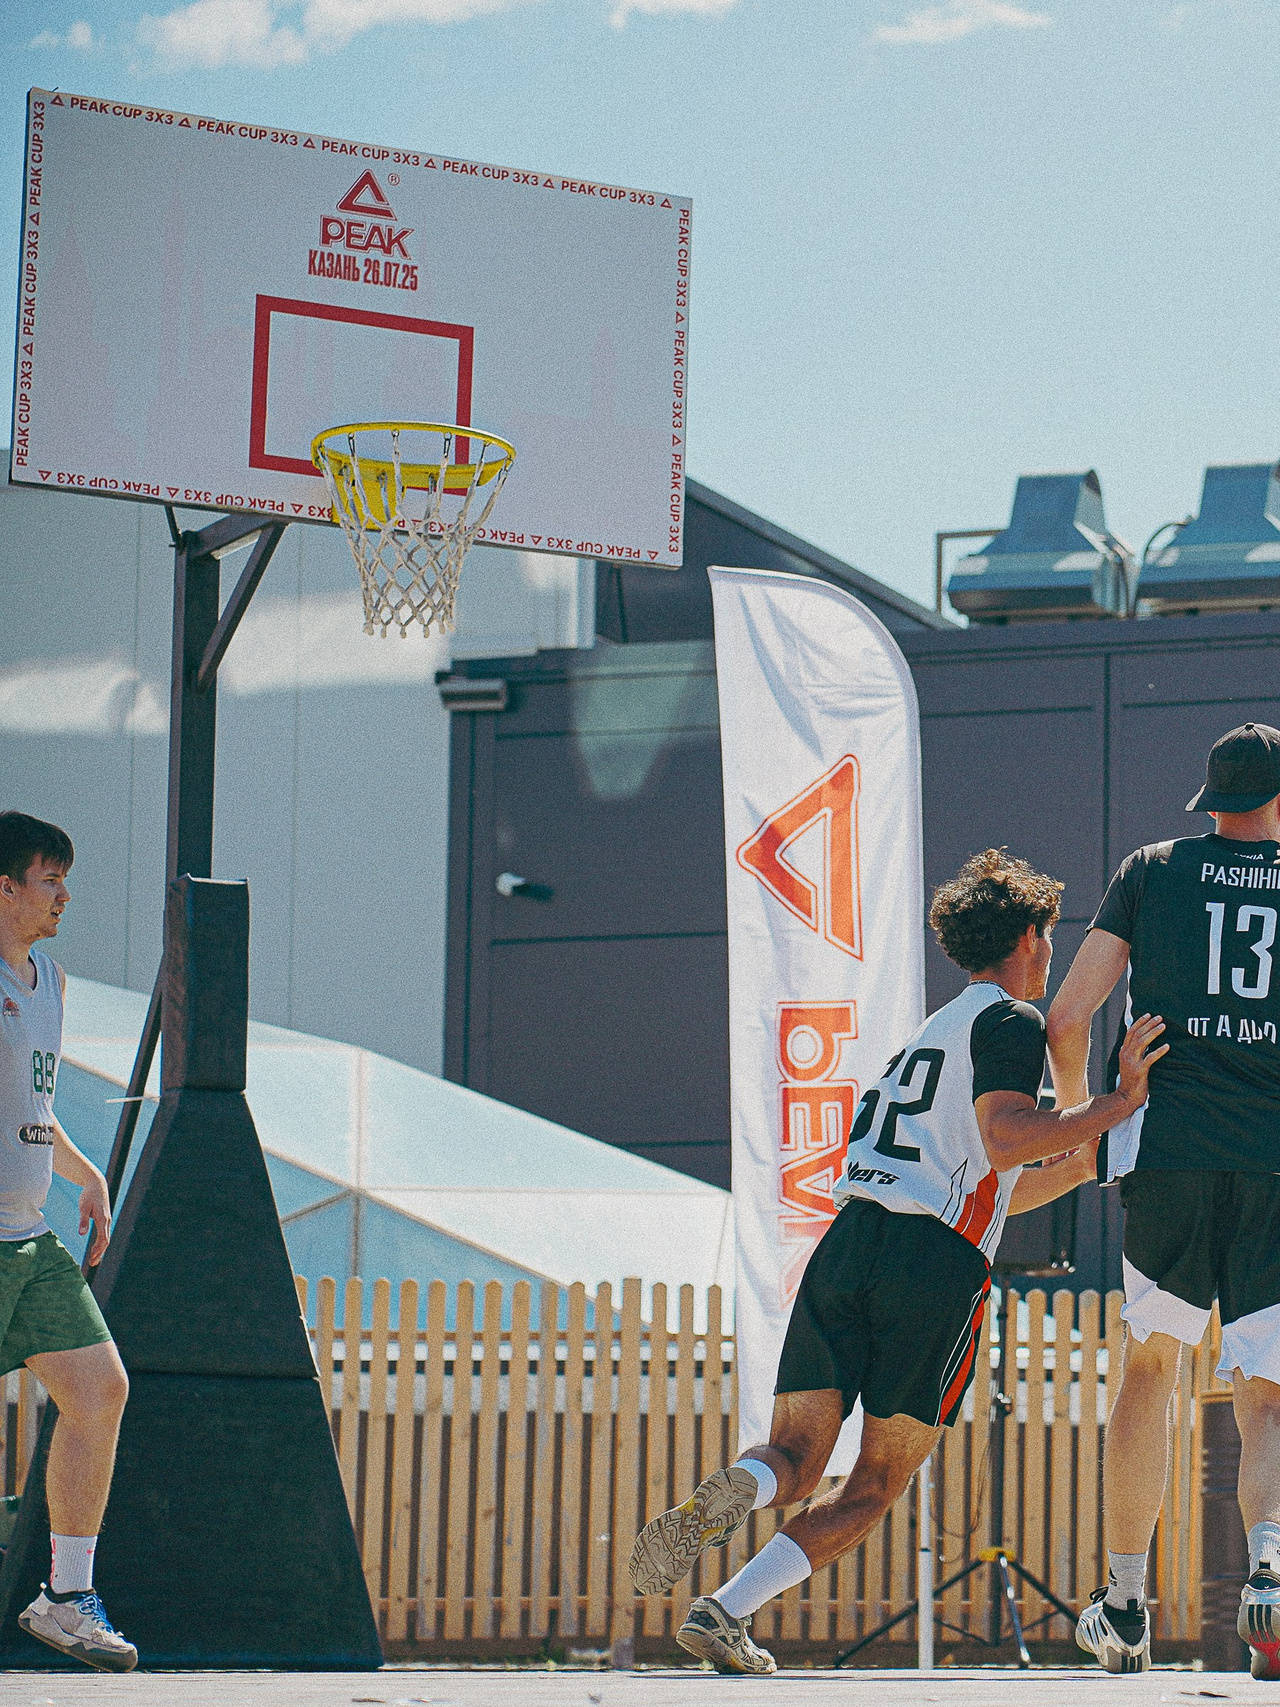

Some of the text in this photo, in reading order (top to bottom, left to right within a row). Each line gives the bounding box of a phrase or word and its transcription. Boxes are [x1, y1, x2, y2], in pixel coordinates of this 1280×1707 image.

[70, 96, 655, 206] PEAK CUP 3X3 PEAK CUP 3X3 PEAK CUP 3X3 PEAK CUP 3X3 PEAK CUP 3X3
[320, 214, 415, 260] PEAK
[308, 249, 418, 291] КАЗАНЬ 26.07.25
[16, 101, 45, 467] PEAK CUP 3X3 PEAK CUP 3X3 PEAK CUP 3X3
[669, 208, 690, 553] PEAK CUP 3X3 PEAK CUP 3X3 PEAK CUP 3X3
[56, 472, 85, 486] 3X3
[89, 477, 118, 490] CUP
[123, 480, 159, 496] PEAK
[184, 488, 211, 503] 3X3
[216, 494, 244, 507] CUP
[249, 496, 284, 513] PEAK
[489, 529, 524, 544] PEAK
[547, 537, 572, 550] 3X3
[577, 539, 603, 554] CUP
[607, 545, 640, 558] PEAK
[1205, 902, 1277, 999] 13
[33, 1050, 55, 1094] 88
